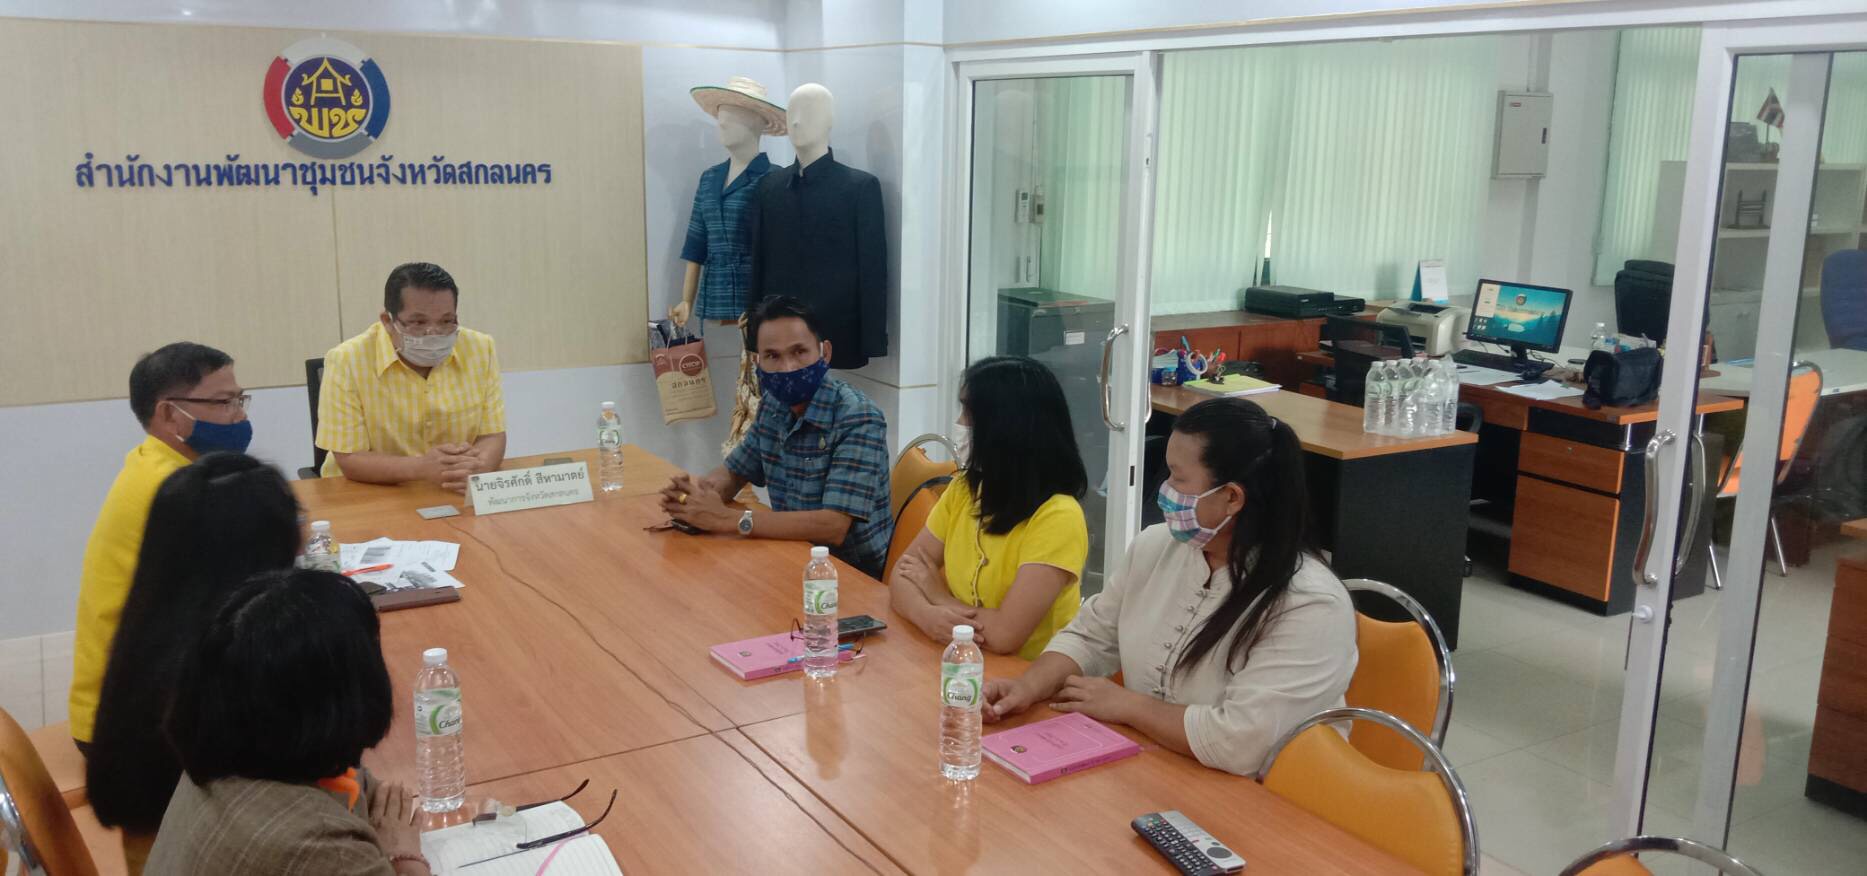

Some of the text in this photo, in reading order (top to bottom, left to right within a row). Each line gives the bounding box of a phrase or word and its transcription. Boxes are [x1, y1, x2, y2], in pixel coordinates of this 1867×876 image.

[75, 152, 553, 197] สำนักงานพัฒนาชุมชนจังหวัดสกลนคร
